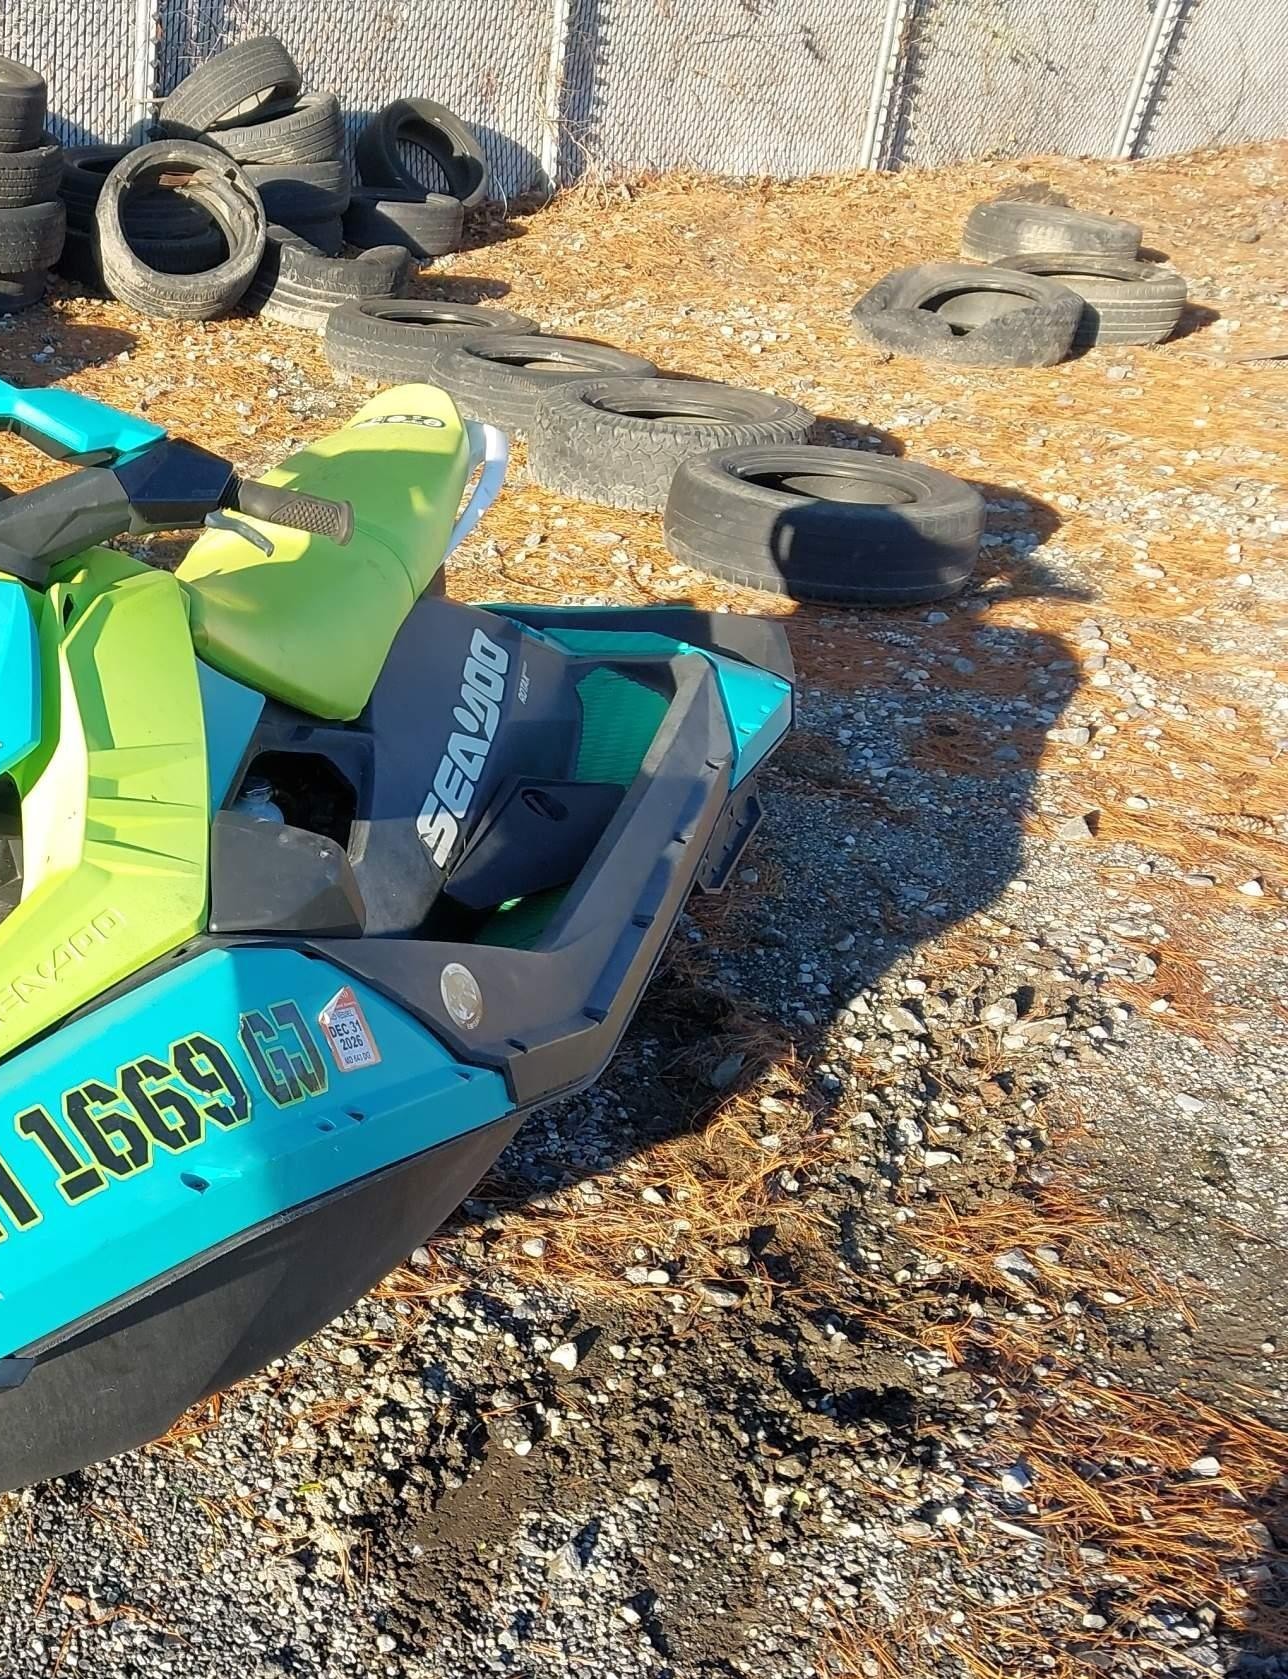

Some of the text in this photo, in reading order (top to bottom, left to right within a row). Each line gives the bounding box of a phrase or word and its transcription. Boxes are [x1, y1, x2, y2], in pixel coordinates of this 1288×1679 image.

[329, 1019, 362, 1038] DEC 31
[340, 1035, 363, 1050] 2026
[15, 1032, 254, 1205] 1669
